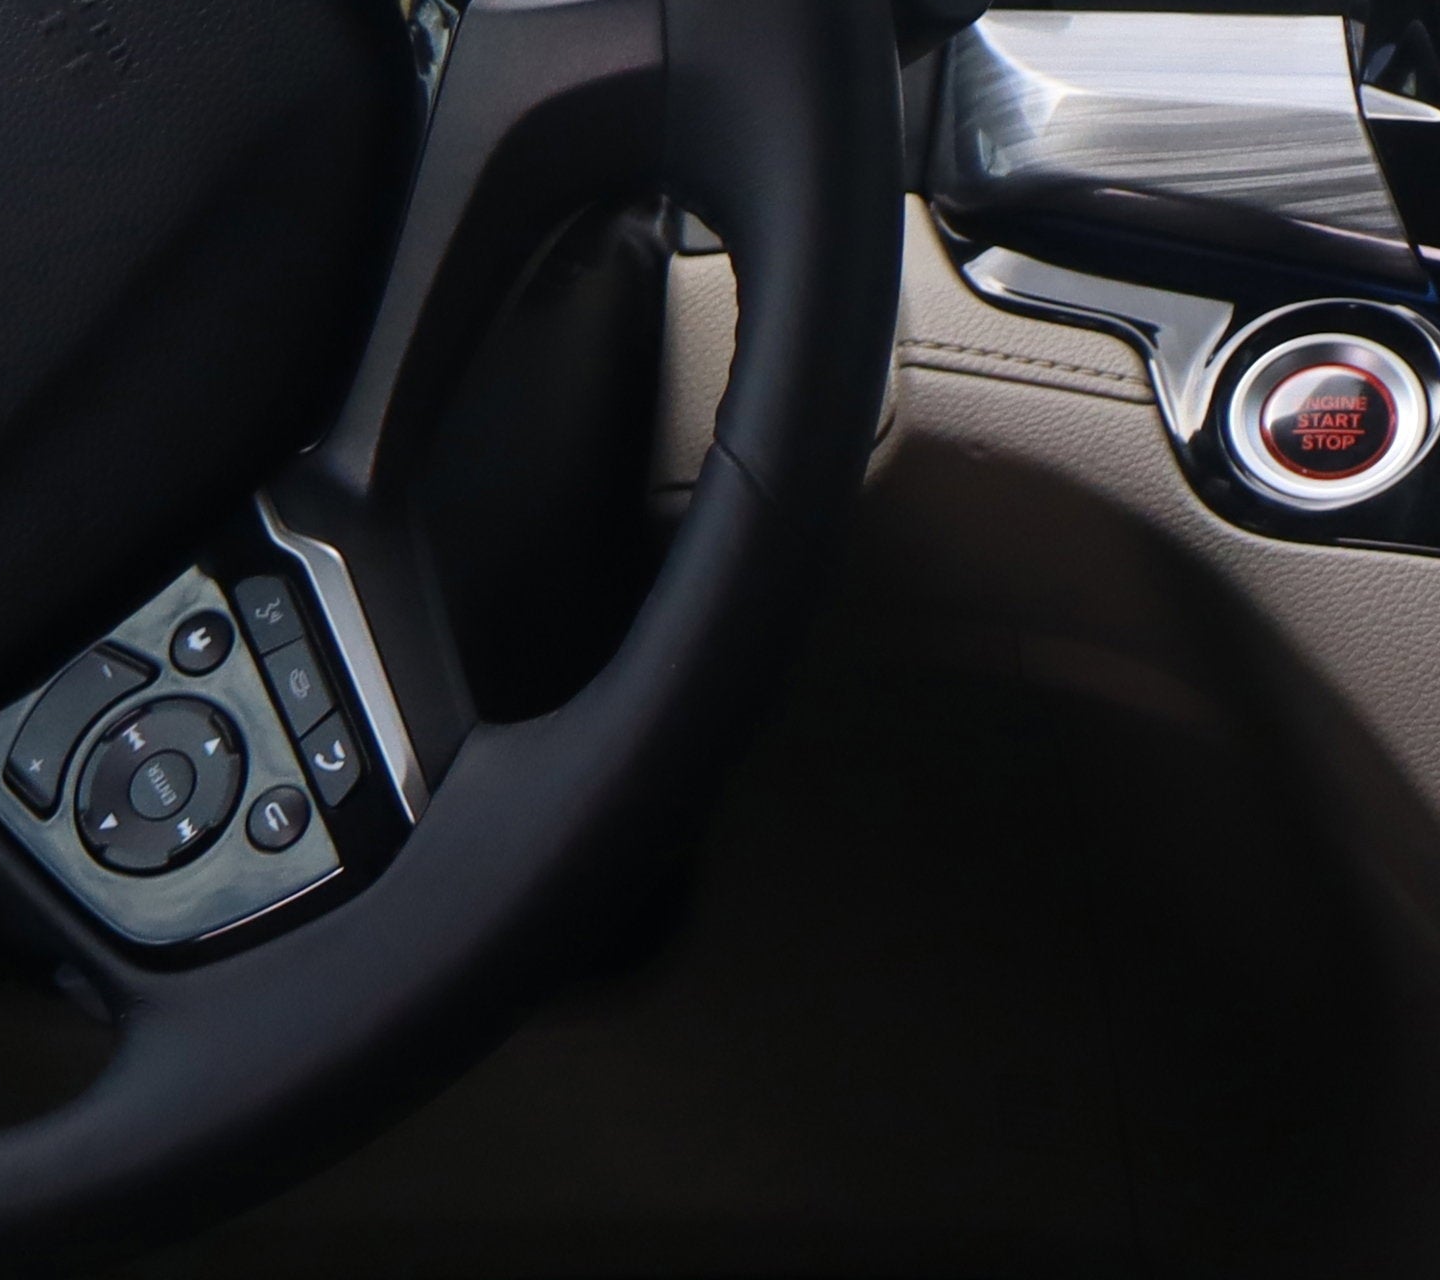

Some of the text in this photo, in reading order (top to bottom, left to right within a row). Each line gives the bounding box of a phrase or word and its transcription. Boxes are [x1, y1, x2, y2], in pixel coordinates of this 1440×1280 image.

[1295, 396, 1369, 412] ENGINE
[1297, 411, 1361, 429] START
[1301, 433, 1357, 451] STOP
[147, 762, 178, 808] ENTER
